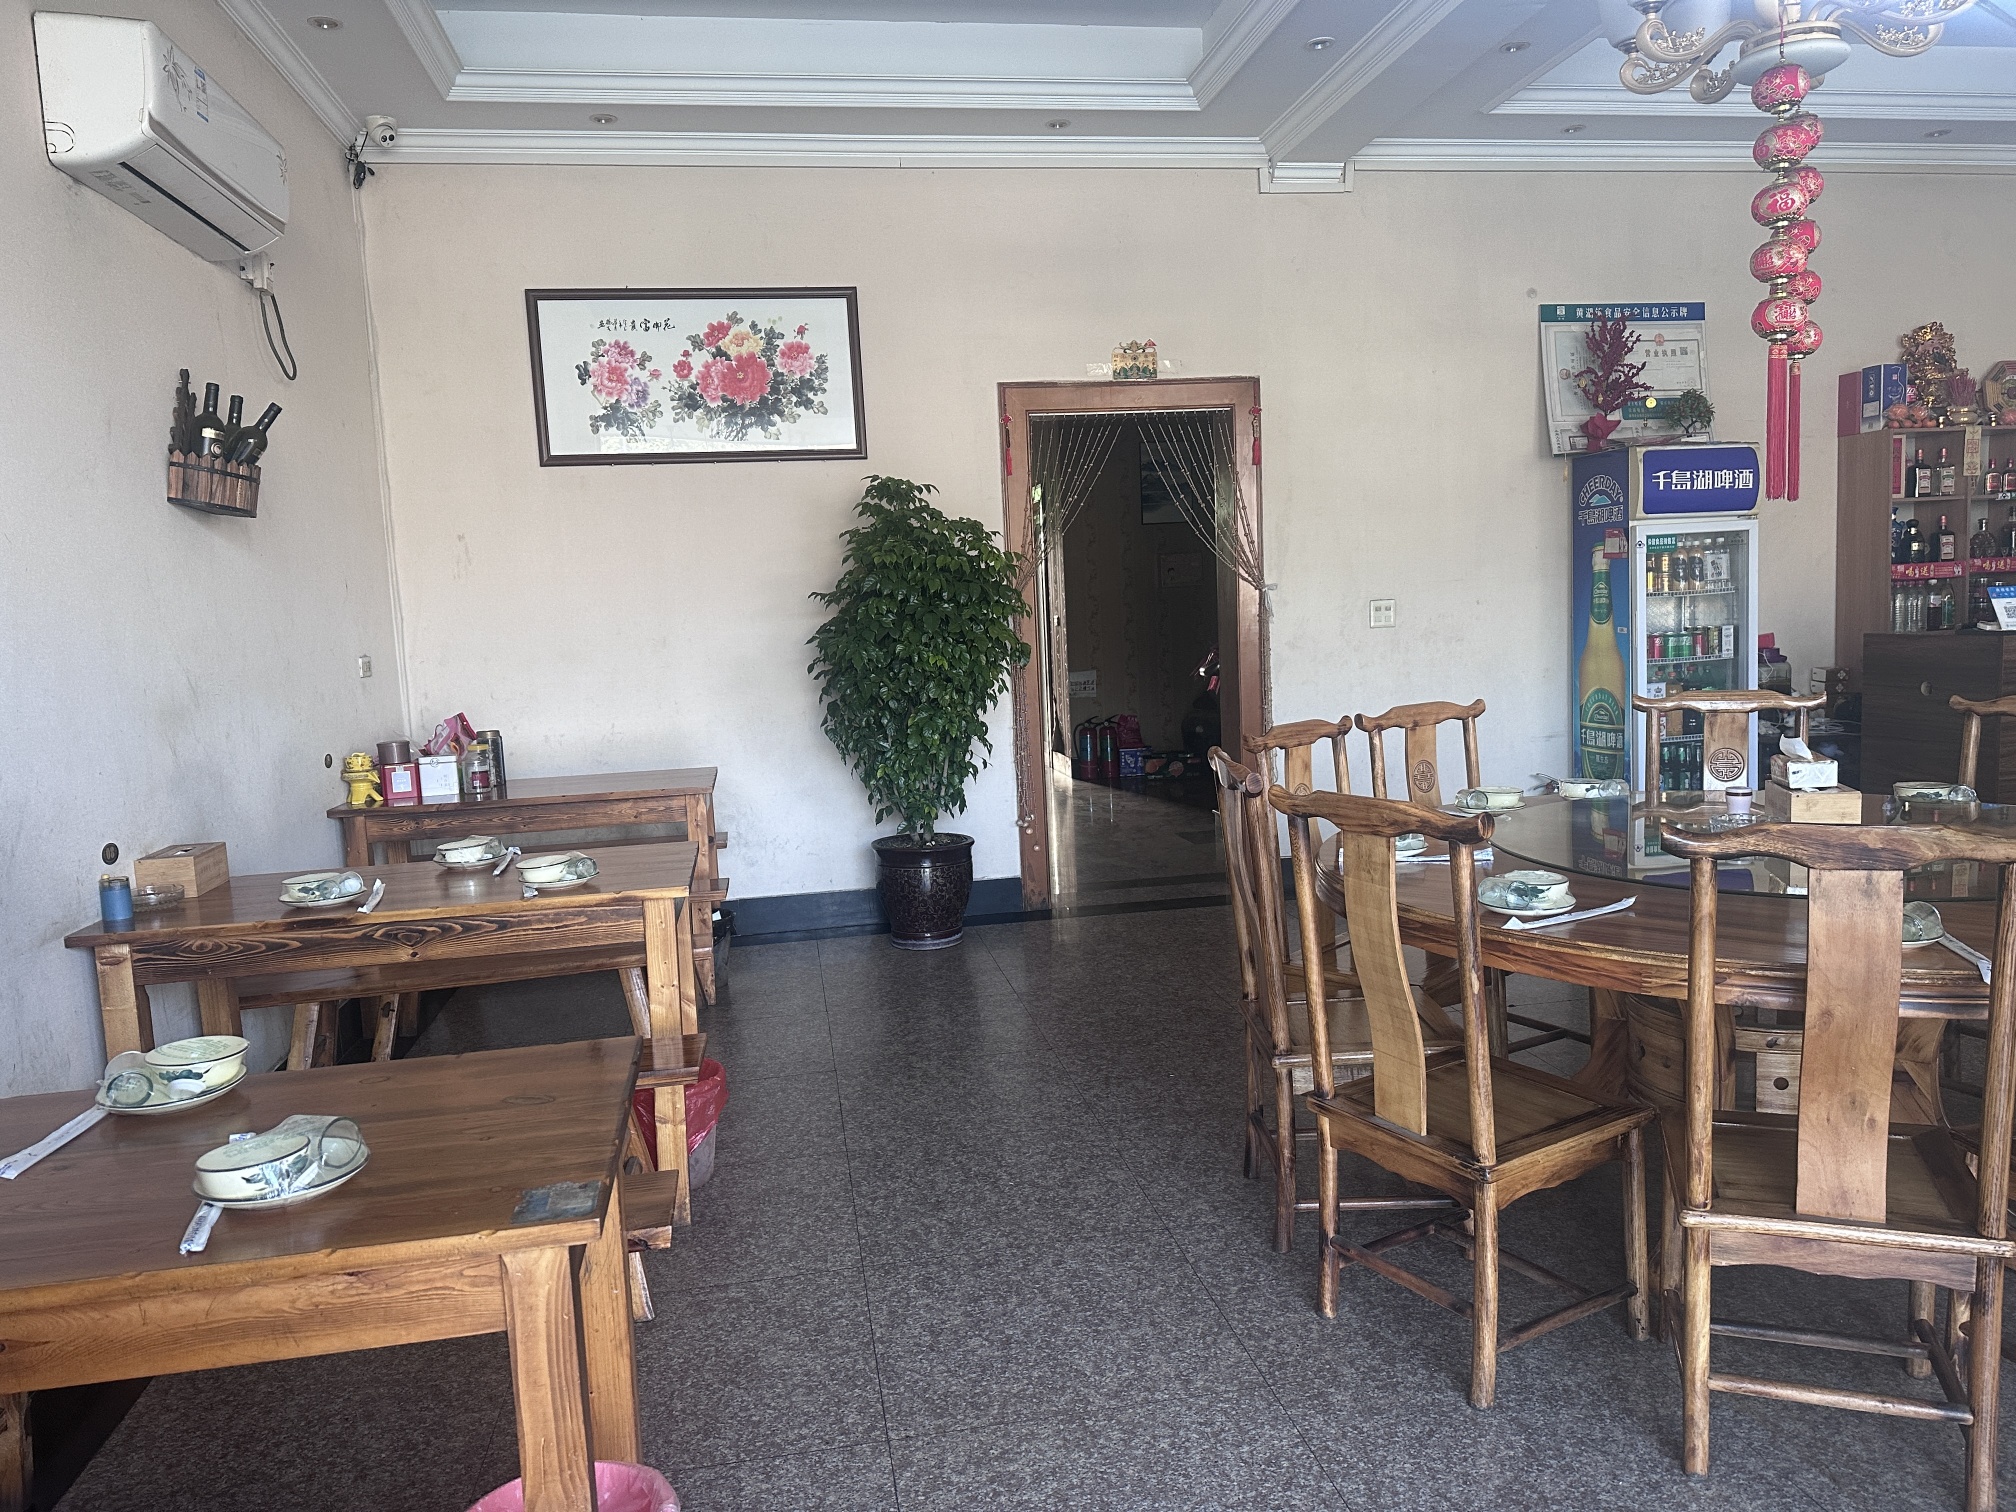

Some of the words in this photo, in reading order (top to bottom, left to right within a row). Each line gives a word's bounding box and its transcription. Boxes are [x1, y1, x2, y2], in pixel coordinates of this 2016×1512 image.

[1645, 348, 1677, 358] 营业执照
[1578, 474, 1622, 507] CHEERDAY
